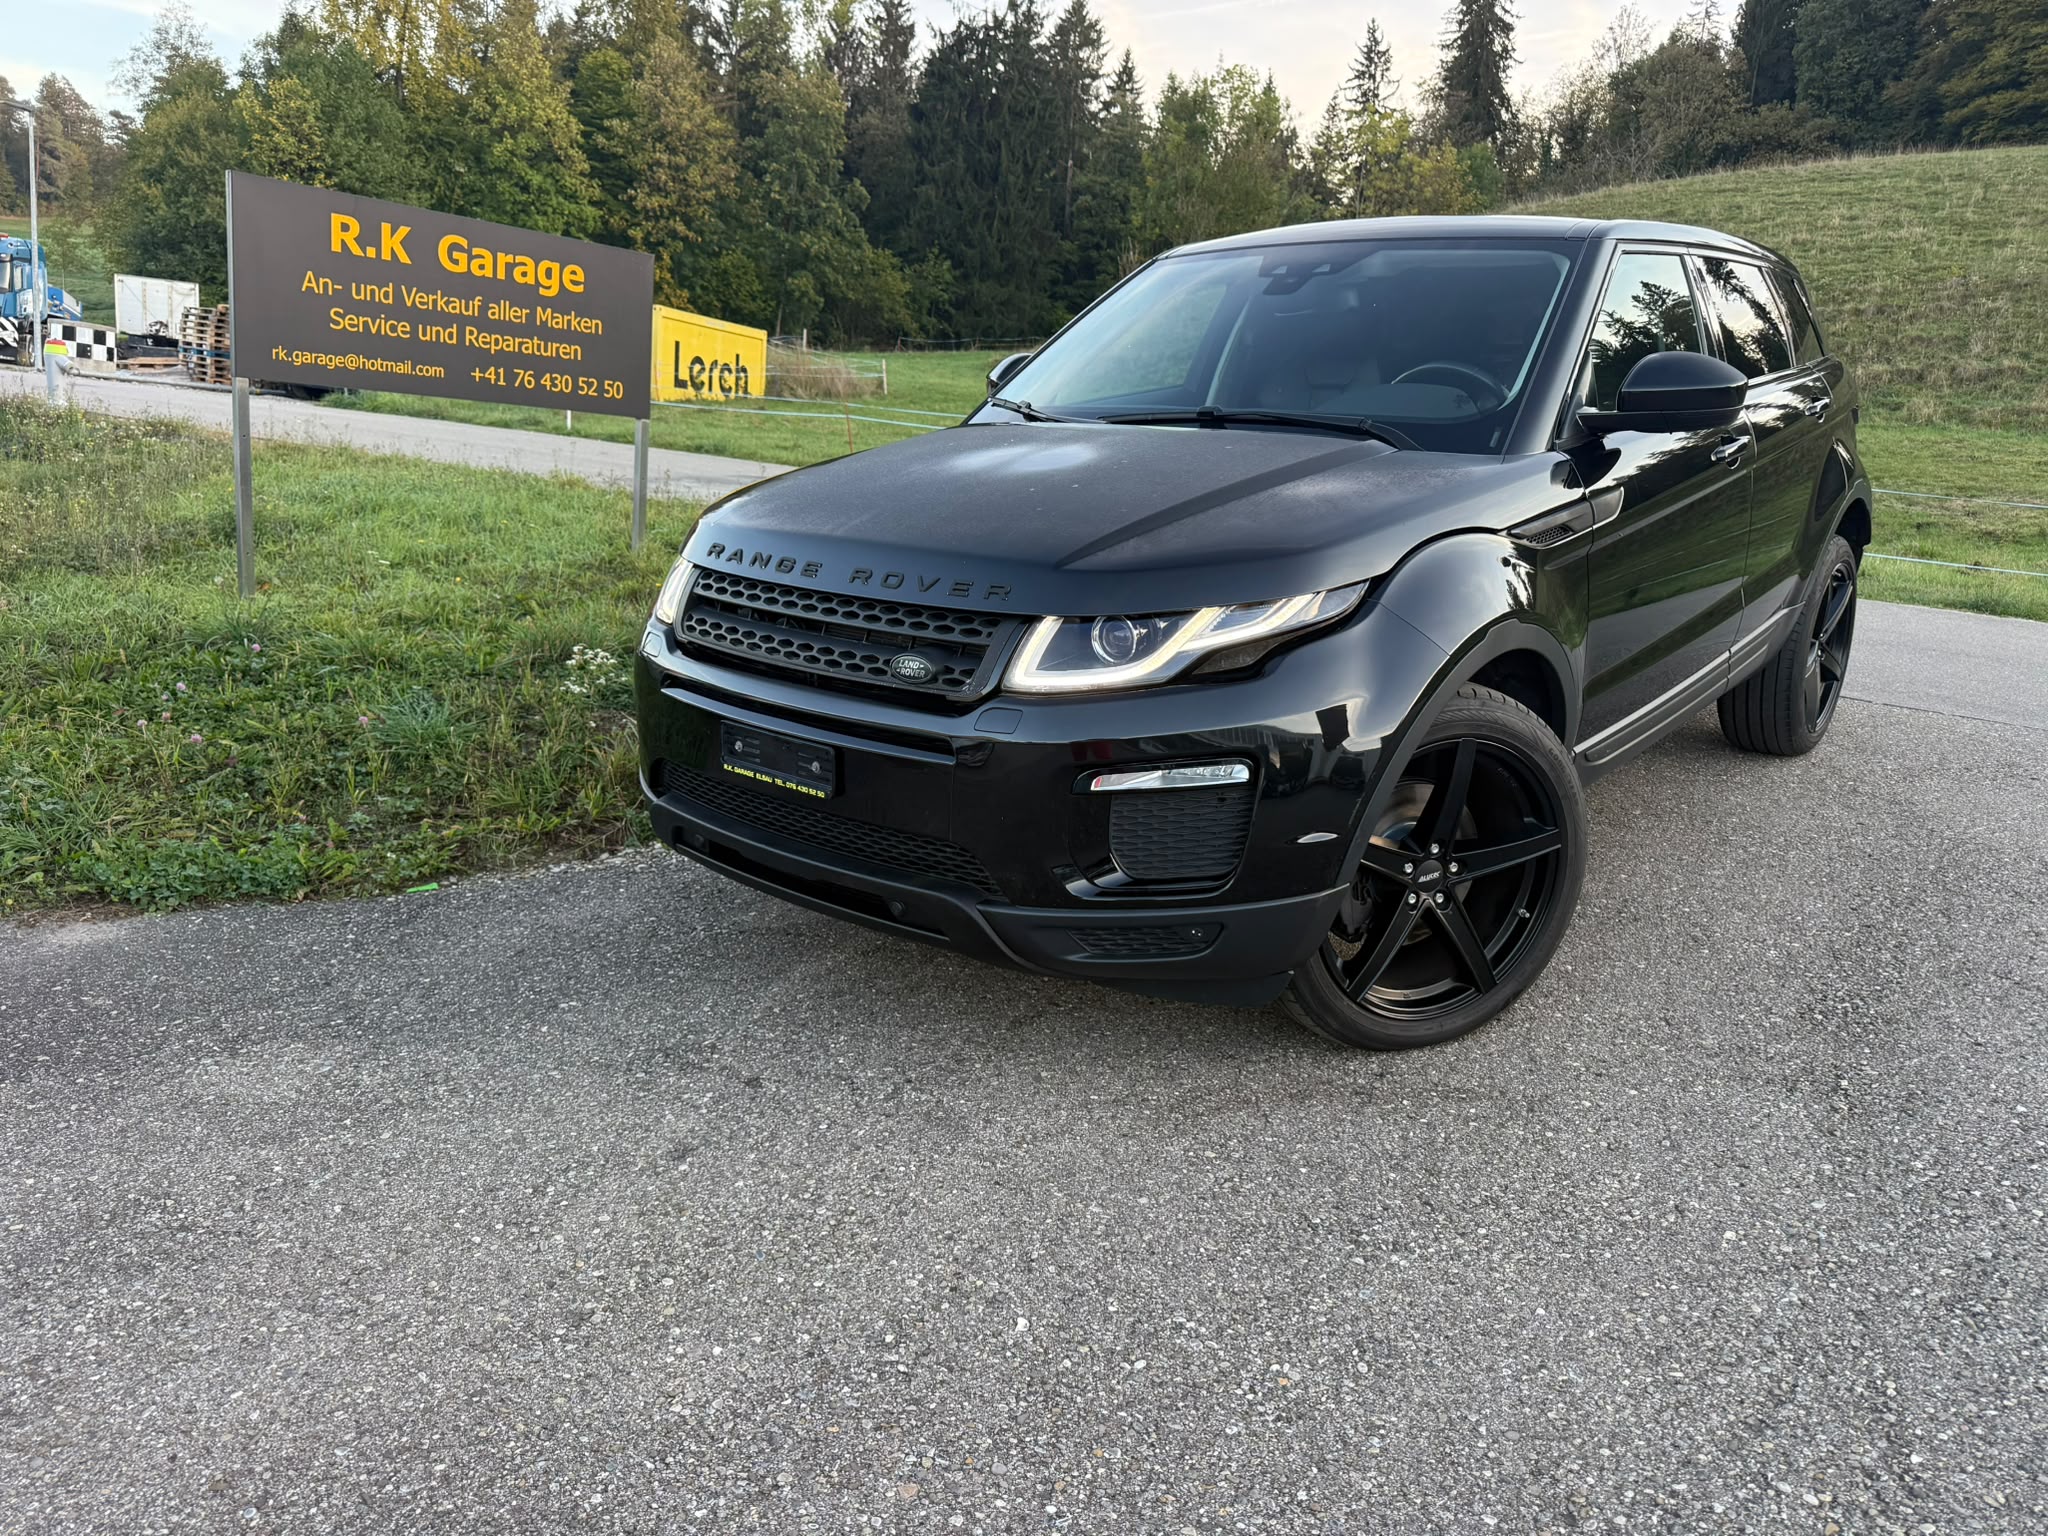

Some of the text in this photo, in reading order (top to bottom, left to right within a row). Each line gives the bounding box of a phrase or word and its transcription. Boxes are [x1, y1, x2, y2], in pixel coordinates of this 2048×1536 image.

[331, 212, 585, 298] R.K Garage
[302, 271, 603, 335] An- und Verkauf aller Marken
[330, 307, 583, 361] Service und Reparaturen
[272, 346, 625, 400] rk.garage@hotmail.com +41 76 430 52 50
[674, 340, 750, 397] Lerch
[707, 542, 1012, 600] RANGE ROVER
[734, 766, 754, 778] GARAGE
[809, 788, 817, 796] 52
